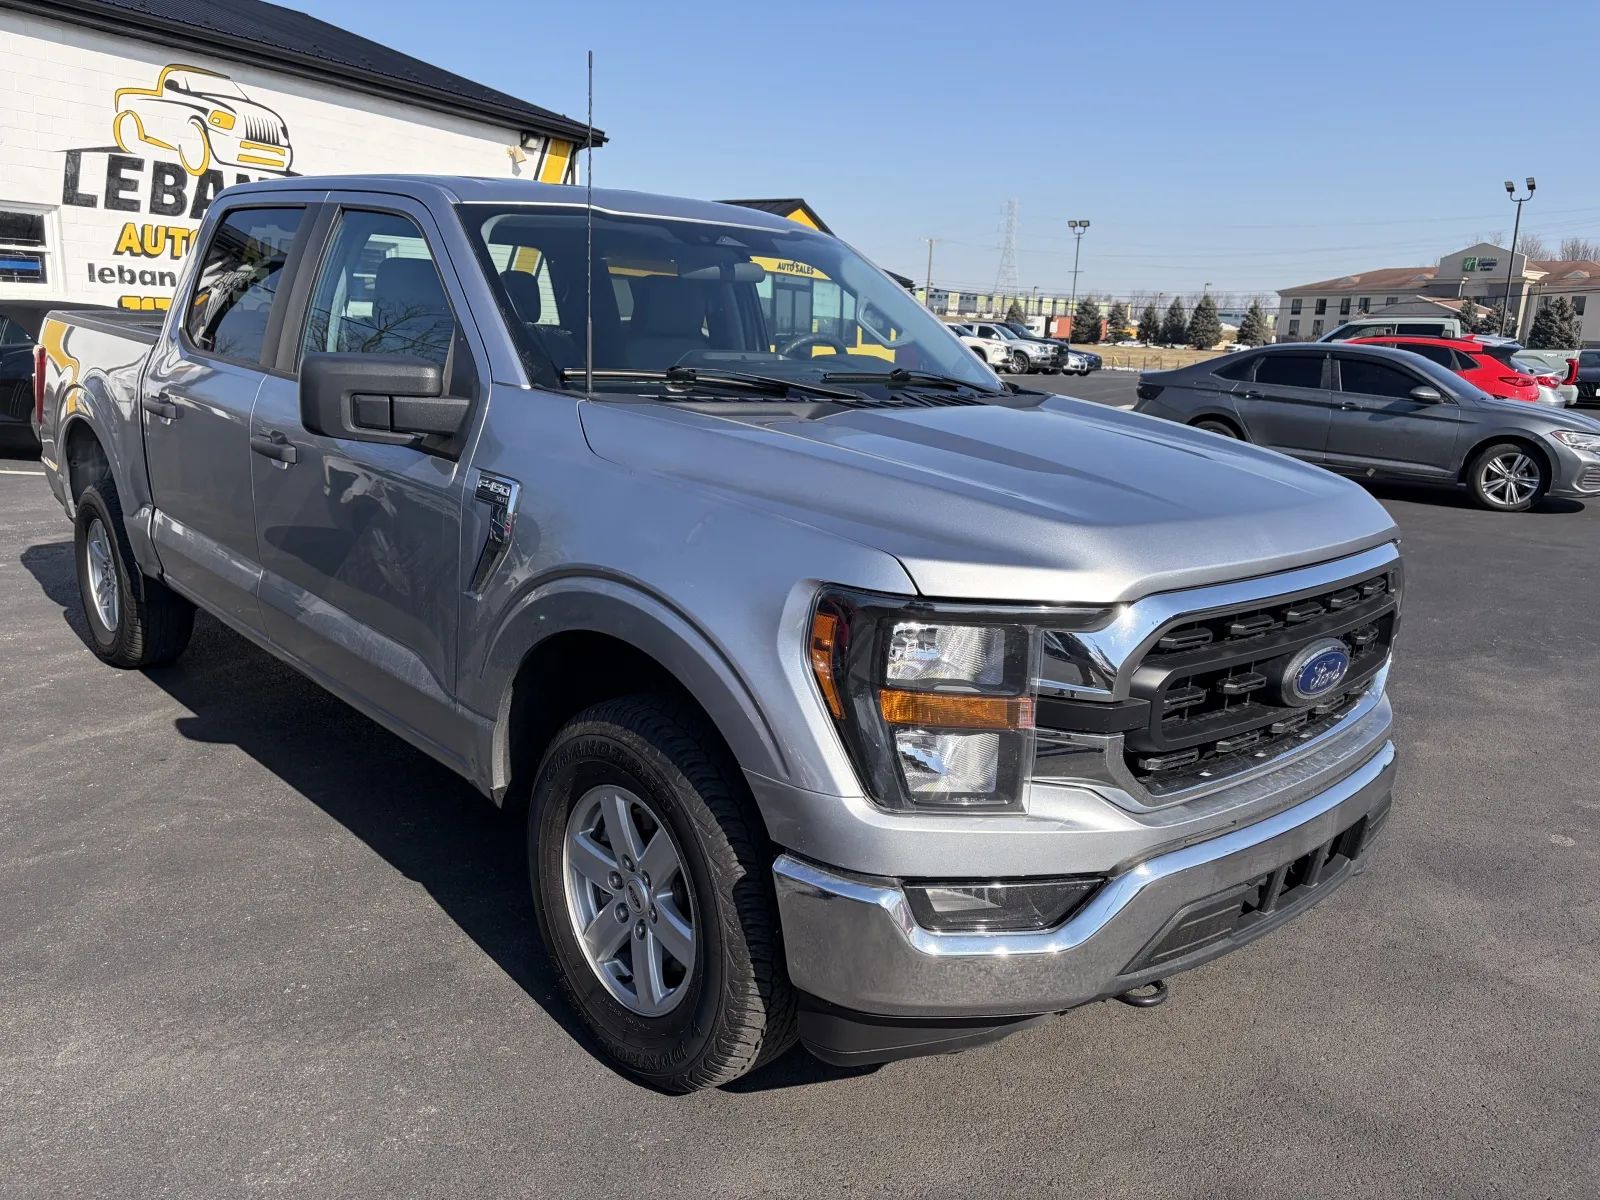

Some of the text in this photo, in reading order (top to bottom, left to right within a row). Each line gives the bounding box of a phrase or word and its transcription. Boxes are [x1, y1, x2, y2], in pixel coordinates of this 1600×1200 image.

[777, 262, 815, 275] AUTO SALES
[1309, 659, 1342, 690] Ford
